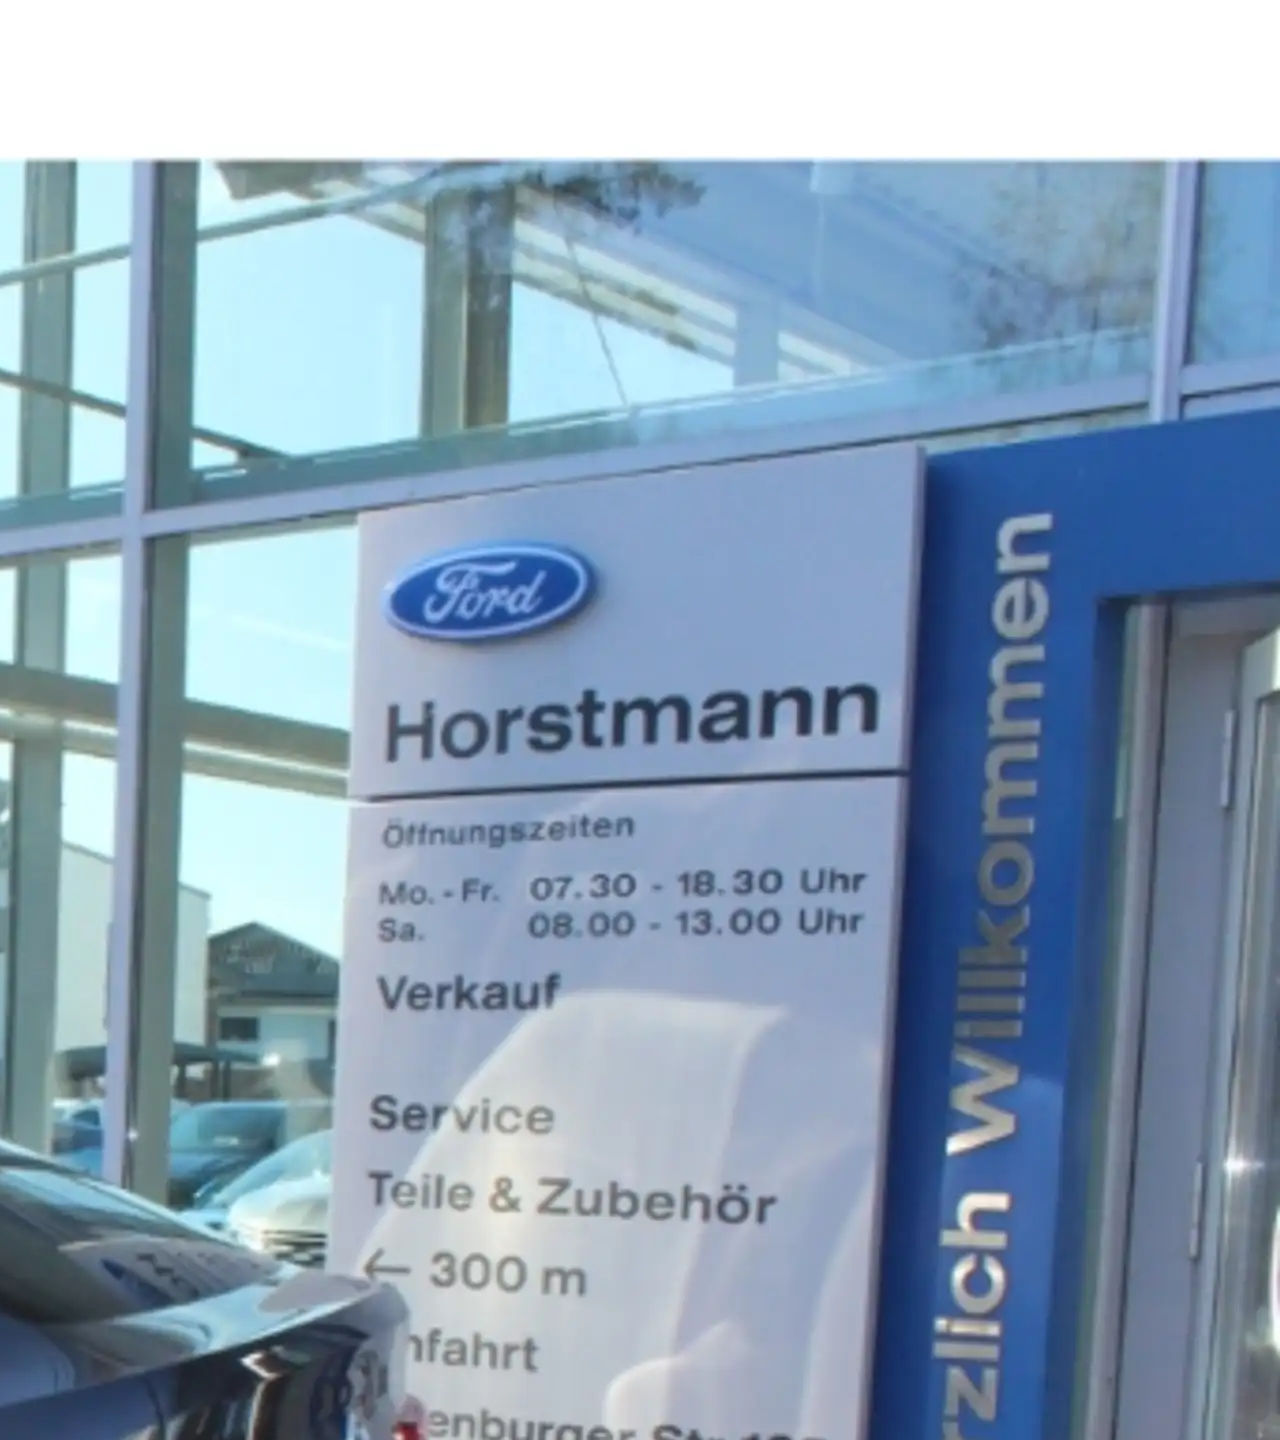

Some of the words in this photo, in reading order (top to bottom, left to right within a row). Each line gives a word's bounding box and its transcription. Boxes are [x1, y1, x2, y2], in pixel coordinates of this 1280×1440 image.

[424, 560, 545, 624] Ford
[385, 683, 879, 763] Horstmann
[382, 815, 635, 850] Öffnungszeiten
[946, 512, 1053, 1157] Willkommen
[378, 882, 435, 905] Mo.
[461, 877, 500, 902] Fr.
[529, 872, 637, 901] 07.30
[677, 868, 783, 898] 18.30
[800, 867, 867, 895] Uhr
[378, 917, 425, 943] Sa.
[527, 911, 636, 938] 08.00
[675, 907, 782, 936] 13.00
[797, 907, 864, 936] Uhr
[378, 974, 561, 1011] Verkauf
[369, 1096, 555, 1135] Service
[368, 1171, 476, 1211] Teile
[488, 1177, 522, 1213] &
[536, 1178, 779, 1225] Zubehör
[428, 1252, 527, 1292] 300
[541, 1264, 587, 1296] m
[408, 1327, 540, 1373] nfahrt
